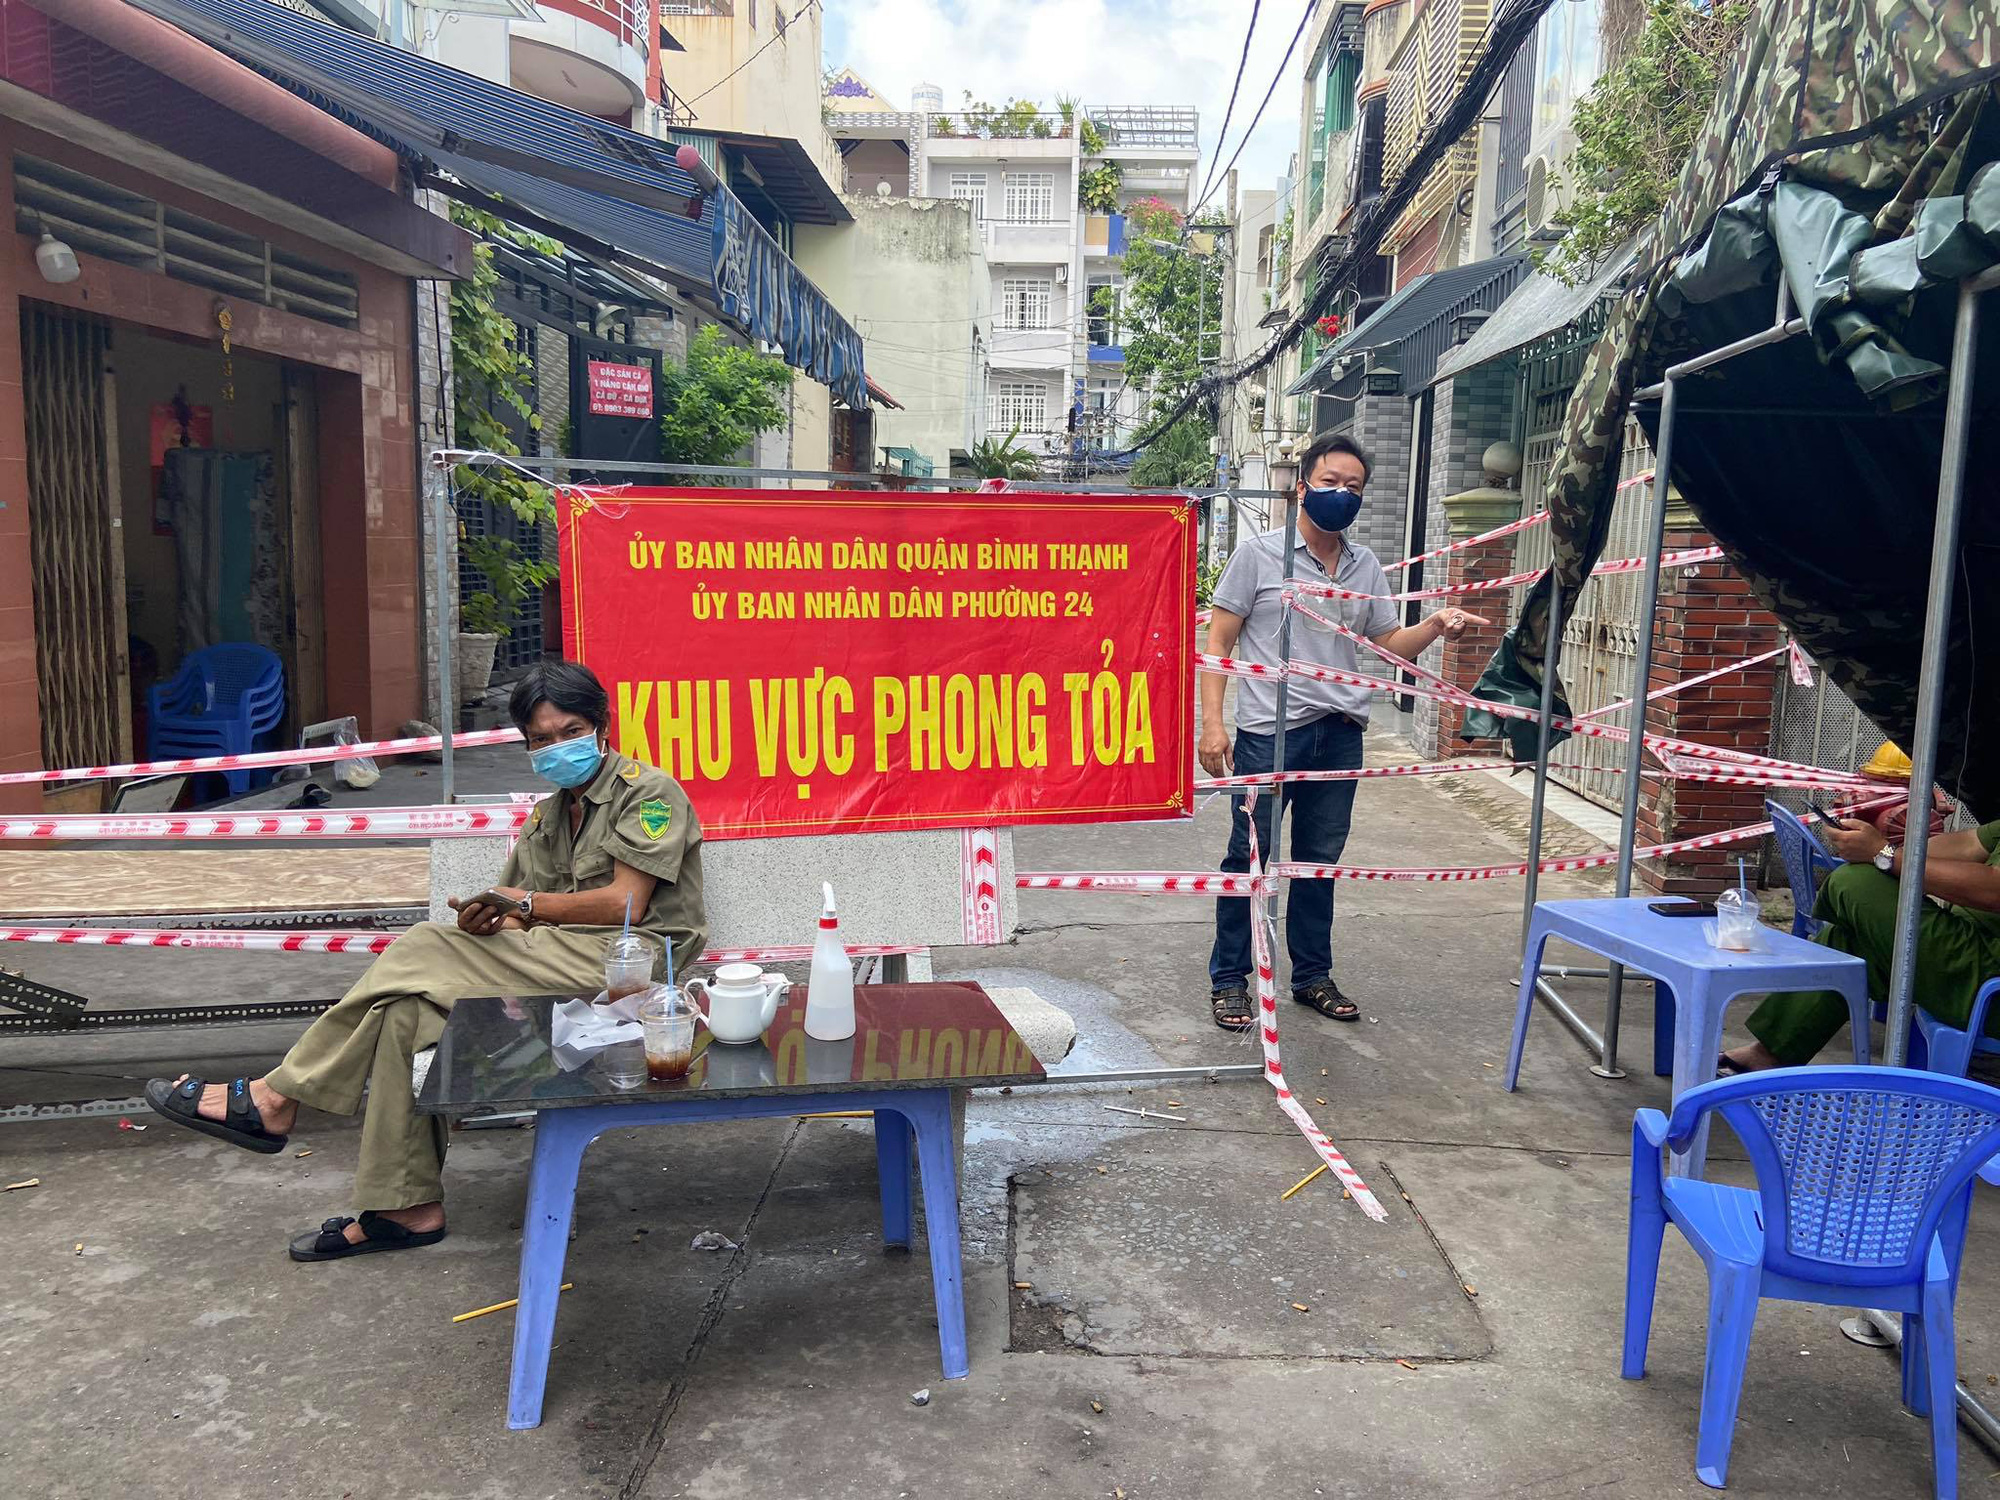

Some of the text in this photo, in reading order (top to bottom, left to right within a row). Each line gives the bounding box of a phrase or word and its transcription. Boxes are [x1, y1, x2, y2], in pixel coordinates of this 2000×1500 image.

[629, 531, 1128, 576] ỦY BAN NHÂN DÂN QUẬN BÌNH THẠNH
[692, 582, 1094, 620] ỦY BAN NHÂN DÂN PHƯỜNG 24
[617, 638, 1155, 800] KHU VỰC PHONG TỎA
